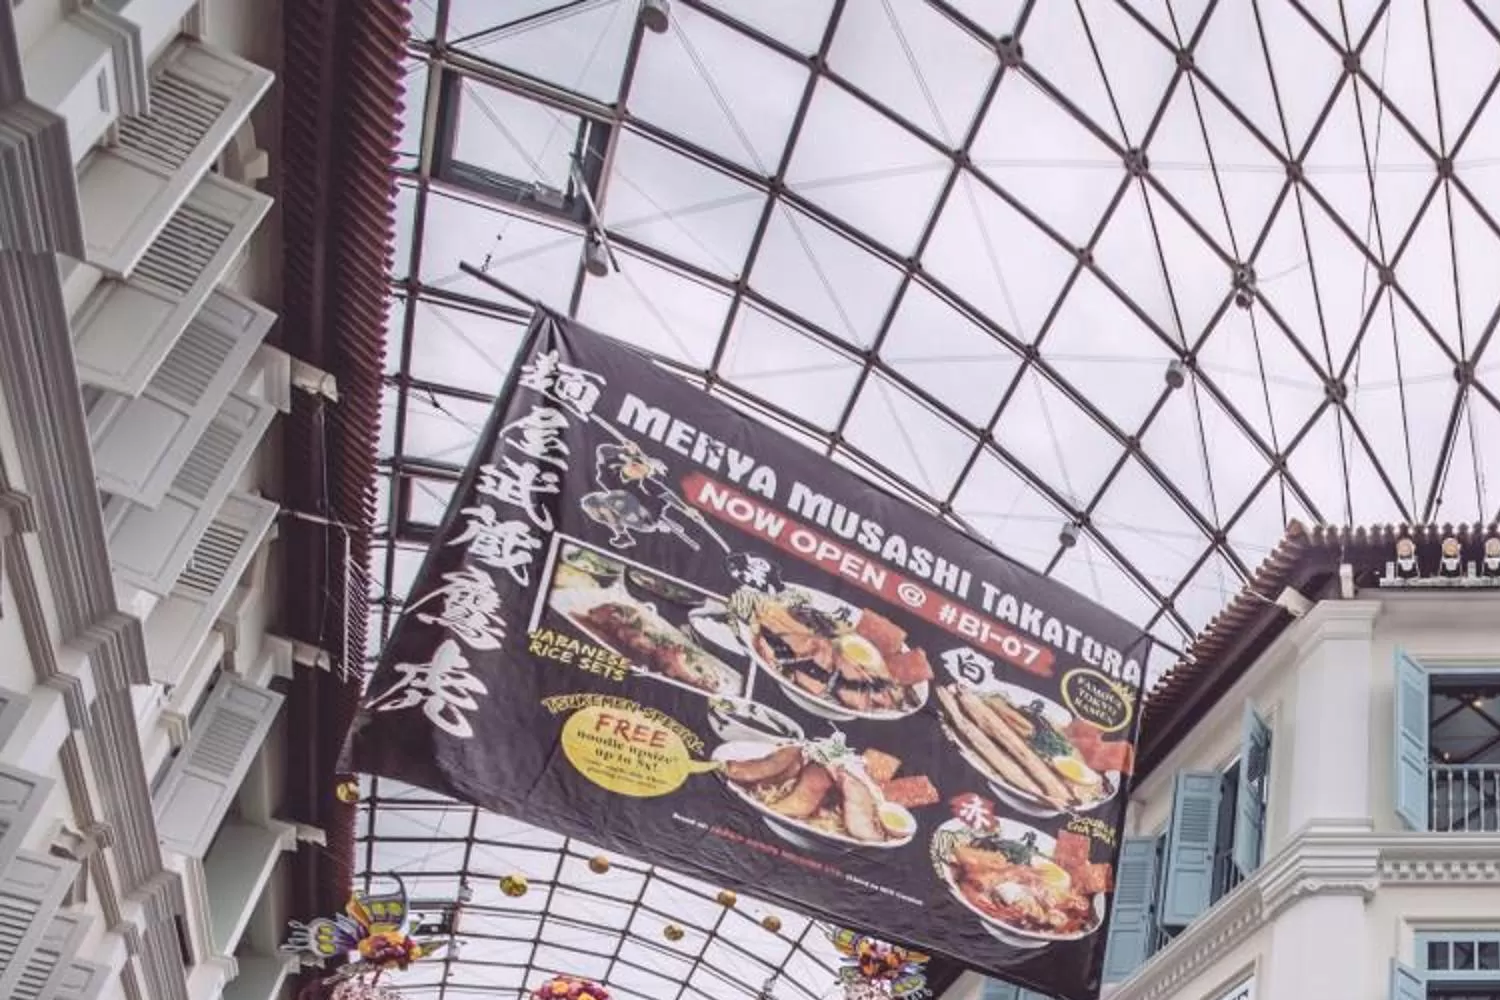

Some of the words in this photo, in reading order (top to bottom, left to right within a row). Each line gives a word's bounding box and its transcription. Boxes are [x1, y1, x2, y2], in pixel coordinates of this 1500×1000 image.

[615, 392, 778, 499] MENYA
[787, 480, 973, 600] MUSASHI
[980, 580, 1142, 689] TAKATORA
[699, 482, 787, 538] NOW
[790, 530, 889, 591] OPEN
[897, 582, 927, 609] @
[938, 603, 1041, 666] #B1-07
[529, 628, 632, 669] JAPANESE
[529, 642, 575, 665] RICE
[577, 657, 627, 682] SETS
[594, 713, 669, 749] FREE
